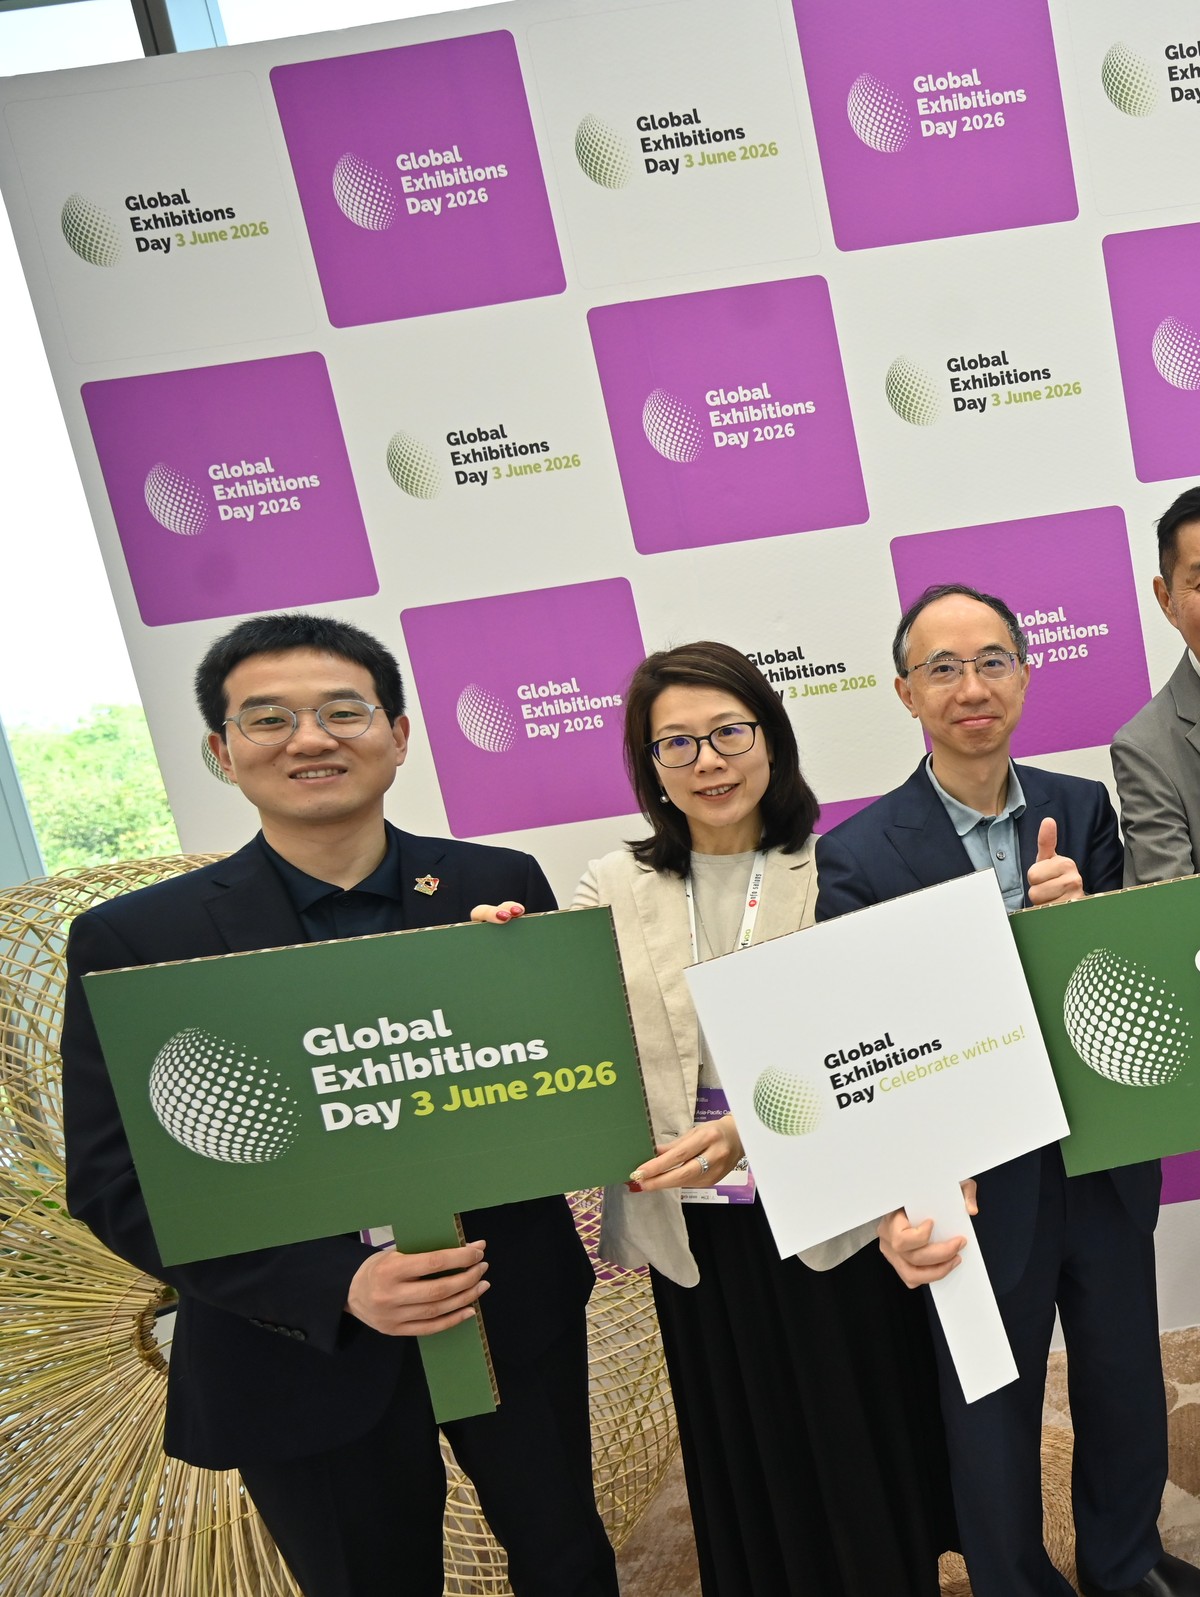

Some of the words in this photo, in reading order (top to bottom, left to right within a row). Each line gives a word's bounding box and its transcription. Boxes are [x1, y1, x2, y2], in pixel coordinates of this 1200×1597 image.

[914, 69, 981, 92] Global
[917, 89, 1026, 115] Exhibitions
[637, 108, 701, 131] Global
[921, 120, 957, 137] Day
[962, 112, 1004, 131] 2026
[640, 128, 745, 152] Exhibitions
[396, 146, 462, 170] Global
[645, 158, 679, 174] Day
[684, 154, 694, 168] 3
[698, 151, 736, 166] June
[739, 142, 778, 160] 2026
[401, 164, 508, 193] Exhibitions
[125, 189, 190, 211] Global
[406, 197, 441, 215] Day
[446, 188, 488, 208] 2026
[130, 208, 235, 232] Exhibitions
[136, 237, 170, 254] Day
[175, 233, 186, 247] 3
[190, 230, 228, 245] June
[230, 222, 268, 239] 2026
[947, 351, 1009, 372] Global
[950, 369, 1051, 392] Exhibitions
[706, 383, 771, 406] Global
[954, 397, 986, 412] Day
[992, 394, 1000, 406] 3
[1005, 390, 1041, 404] June
[1045, 382, 1081, 399] 2026
[709, 401, 815, 427] Exhibitions
[447, 424, 507, 446] Global
[713, 432, 748, 448] Day
[753, 423, 795, 442] 2026
[451, 442, 549, 466] Exhibitions
[209, 457, 274, 480] Global
[455, 470, 487, 485] Day
[492, 467, 502, 479] 3
[506, 463, 541, 477] June
[544, 454, 580, 471] 2026
[213, 475, 320, 500] Exhibitions
[218, 505, 254, 521] Day
[258, 496, 300, 515] 2026
[1016, 606, 1066, 628] lobal
[1025, 623, 1109, 646] hibitions
[1026, 652, 1044, 668] ay
[1048, 644, 1088, 662] 2026
[762, 662, 846, 684] hibitions
[518, 678, 580, 700] Global
[788, 686, 798, 698] 3
[802, 682, 838, 698] June
[840, 675, 877, 692] 2026
[521, 695, 622, 719] Exhibitions
[526, 723, 559, 738] Day
[564, 715, 603, 732] 2026
[303, 1009, 452, 1056] Global
[824, 1033, 894, 1069] Global
[312, 1040, 548, 1094] Exhibitions
[830, 1040, 942, 1090] Exhibitions
[836, 1086, 874, 1109] Day
[879, 1053, 960, 1092] Celebrate
[962, 1036, 998, 1060] with
[1002, 1025, 1026, 1046] us!
[321, 1099, 401, 1131] Day
[411, 1091, 434, 1116] 3
[442, 1080, 528, 1111] June
[533, 1062, 616, 1096] 2026
